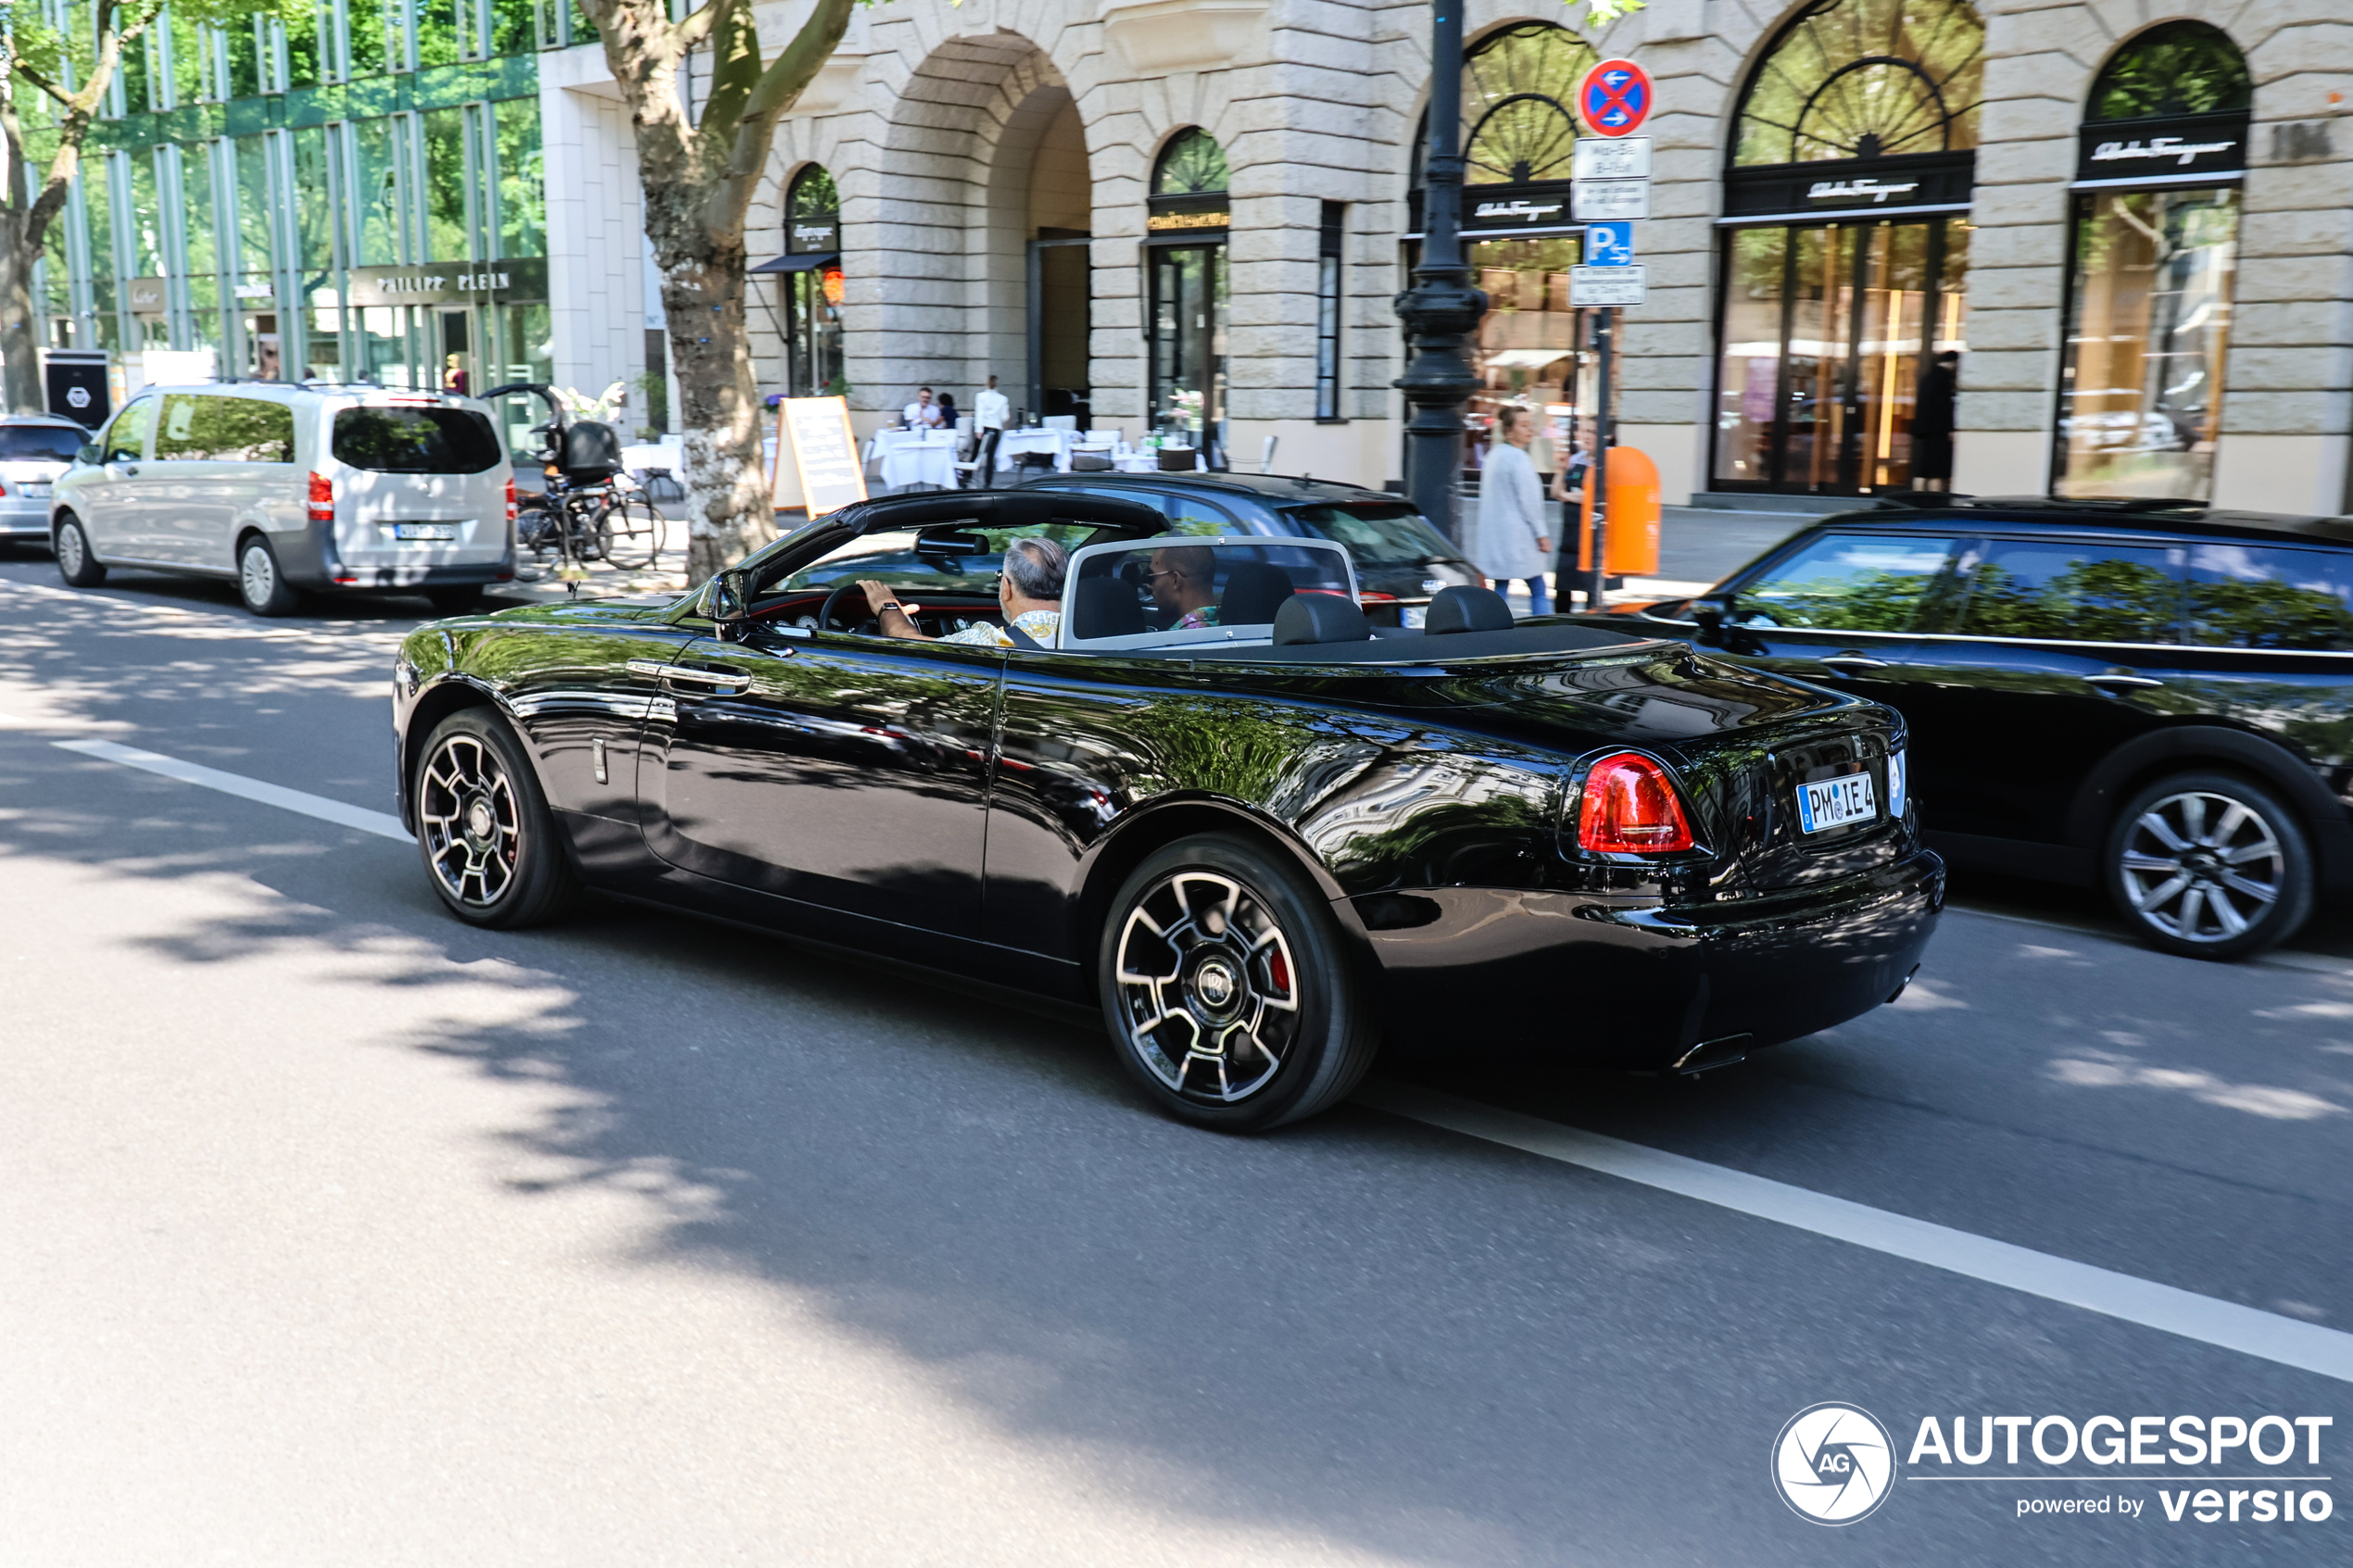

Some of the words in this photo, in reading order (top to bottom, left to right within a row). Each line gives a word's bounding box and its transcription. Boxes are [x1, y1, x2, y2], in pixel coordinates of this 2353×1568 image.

[1589, 227, 1617, 260] P
[377, 276, 446, 293] PHILIPP
[458, 272, 510, 291] PLEIN
[1809, 787, 1834, 823] PM
